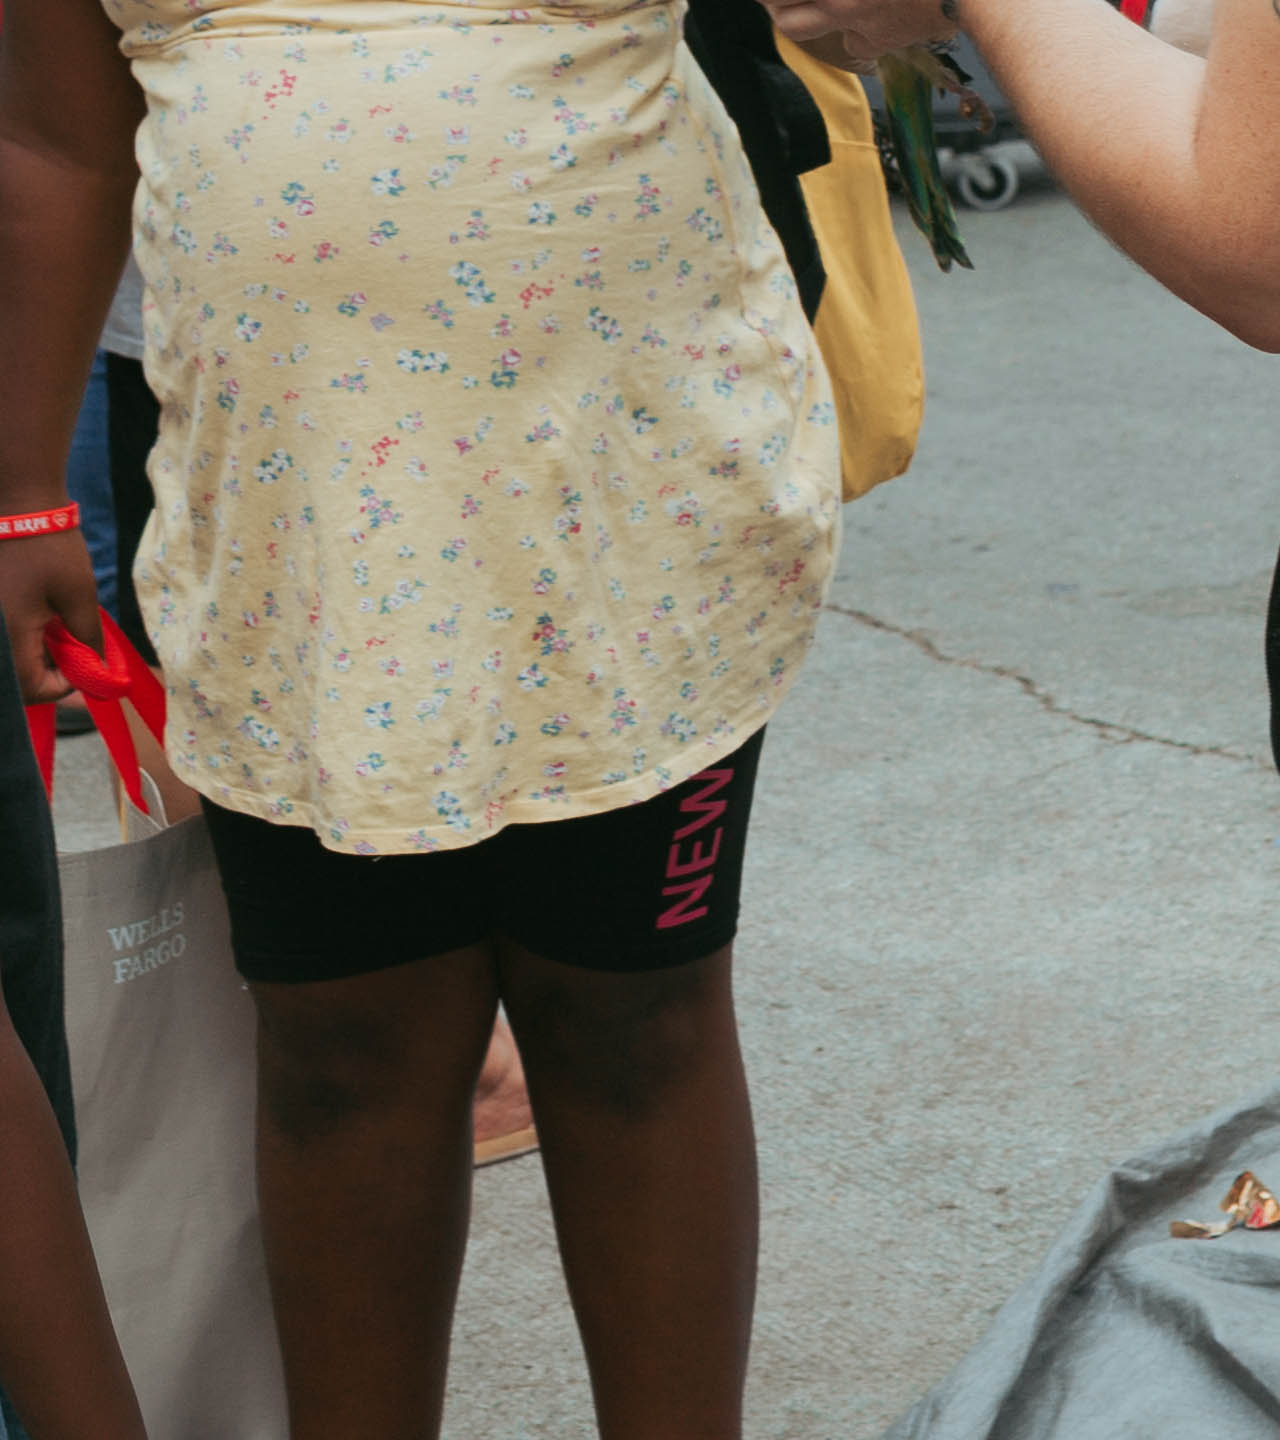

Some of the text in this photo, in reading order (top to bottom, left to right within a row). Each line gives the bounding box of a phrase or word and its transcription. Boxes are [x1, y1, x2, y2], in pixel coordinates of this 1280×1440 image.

[656, 768, 734, 929] NEW
[105, 901, 184, 952] WELLS
[112, 933, 186, 984] FARGO
